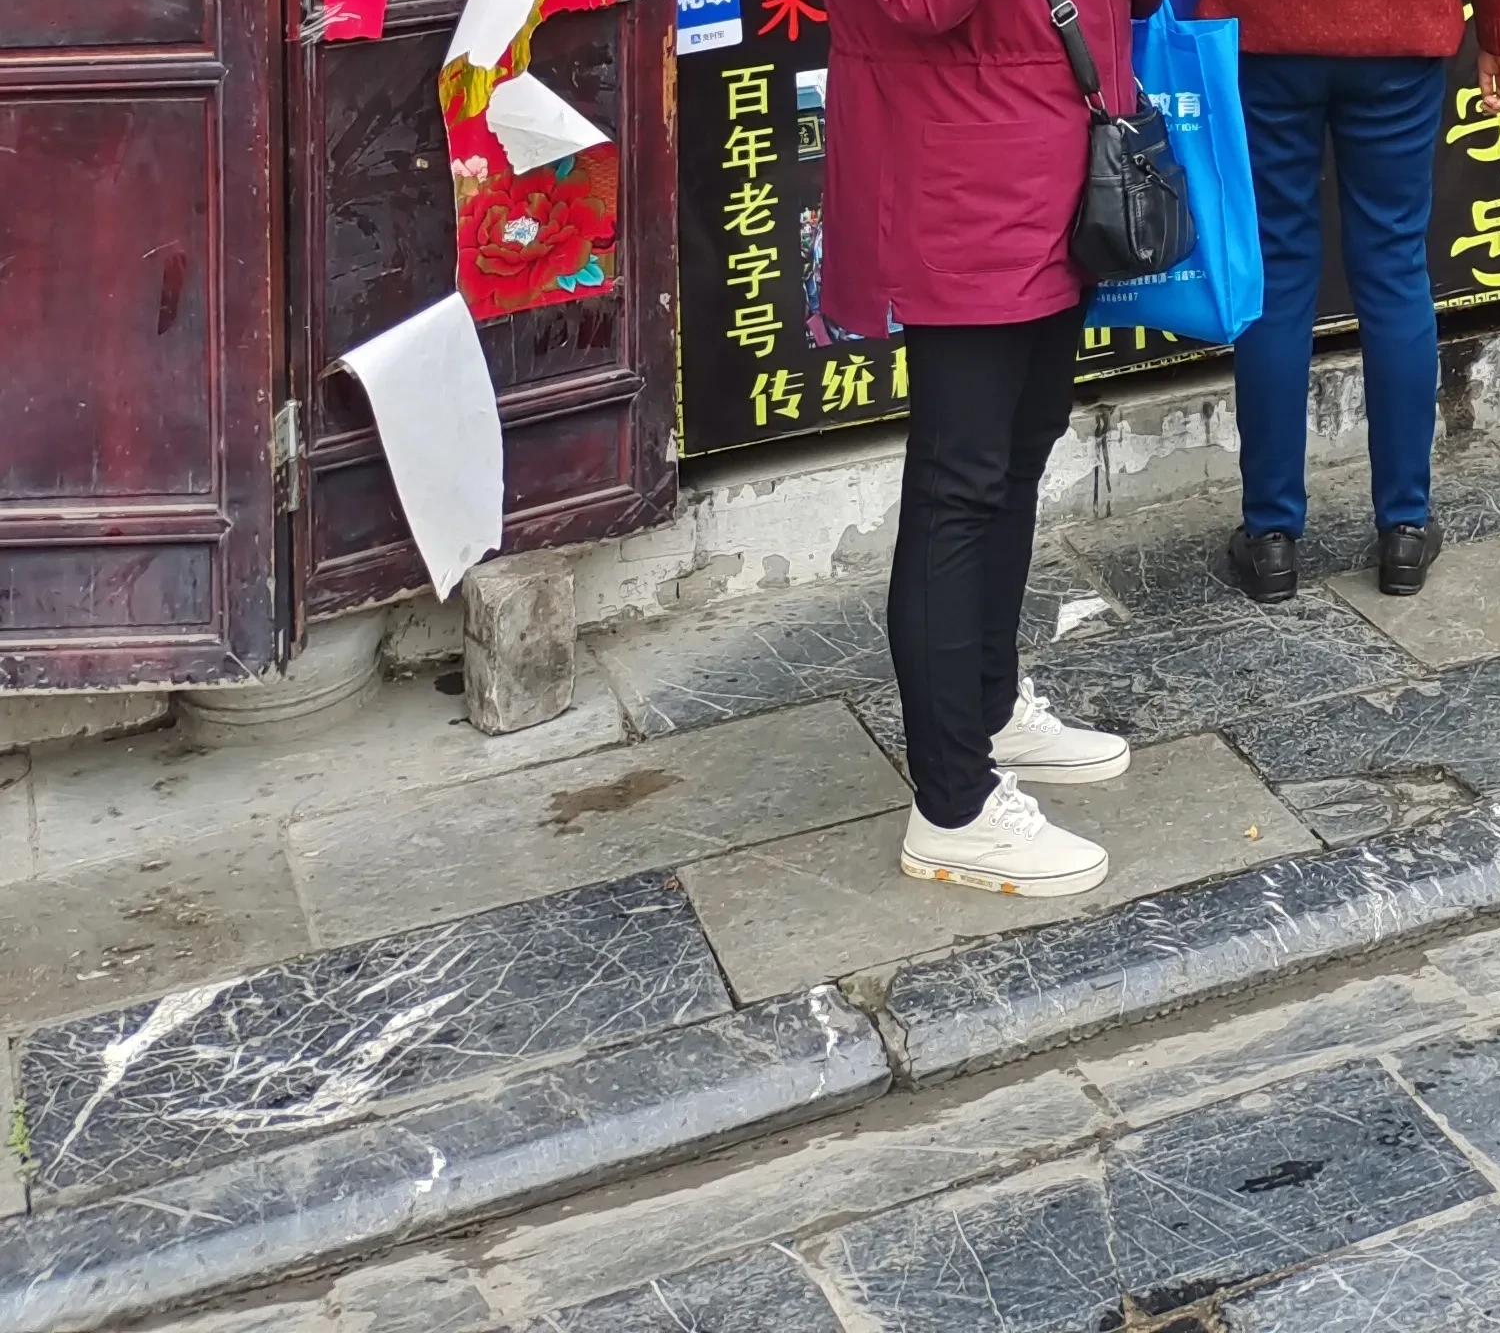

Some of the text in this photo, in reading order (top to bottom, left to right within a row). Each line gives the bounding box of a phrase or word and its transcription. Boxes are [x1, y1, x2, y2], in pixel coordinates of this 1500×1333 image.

[721, 63, 784, 359] 百年老字号
